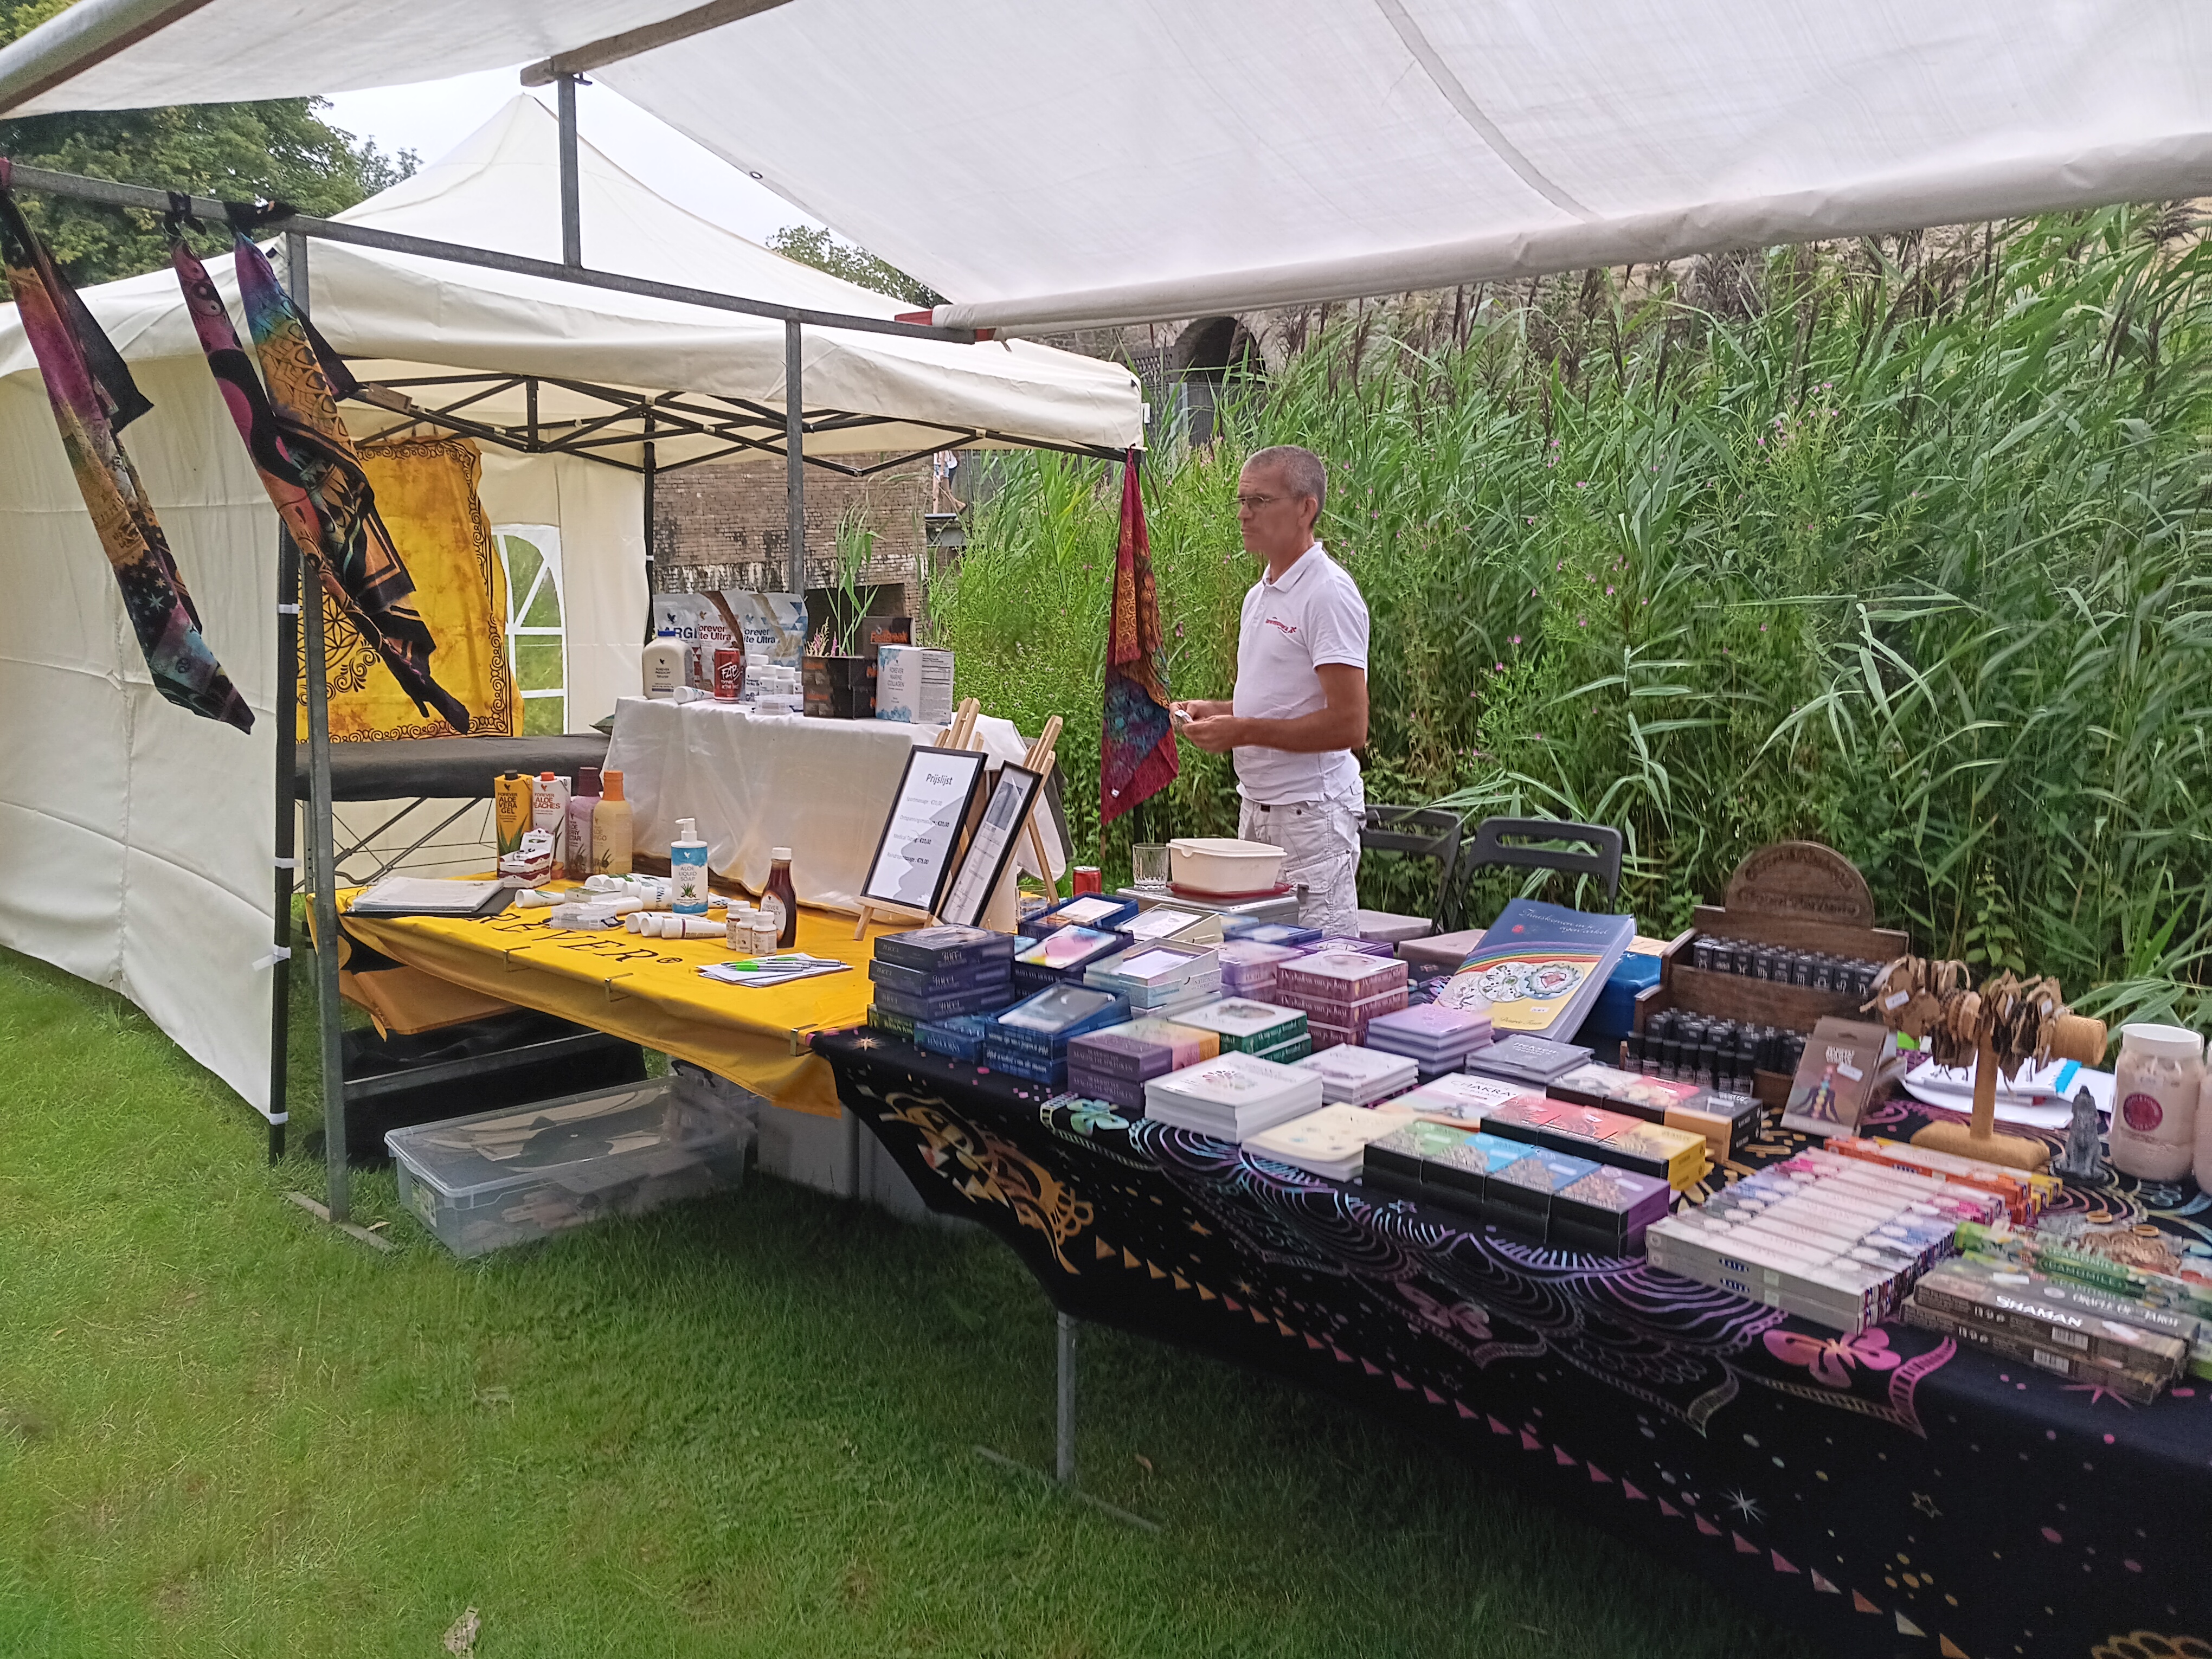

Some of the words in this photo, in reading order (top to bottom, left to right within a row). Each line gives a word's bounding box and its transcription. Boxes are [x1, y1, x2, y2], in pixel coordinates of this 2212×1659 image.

[698, 624, 725, 632] orever
[744, 628, 770, 636] orever
[711, 632, 731, 640] Ultra
[926, 773, 953, 786] Prijslijst
[1996, 1295, 2083, 1327] SHAMAN
